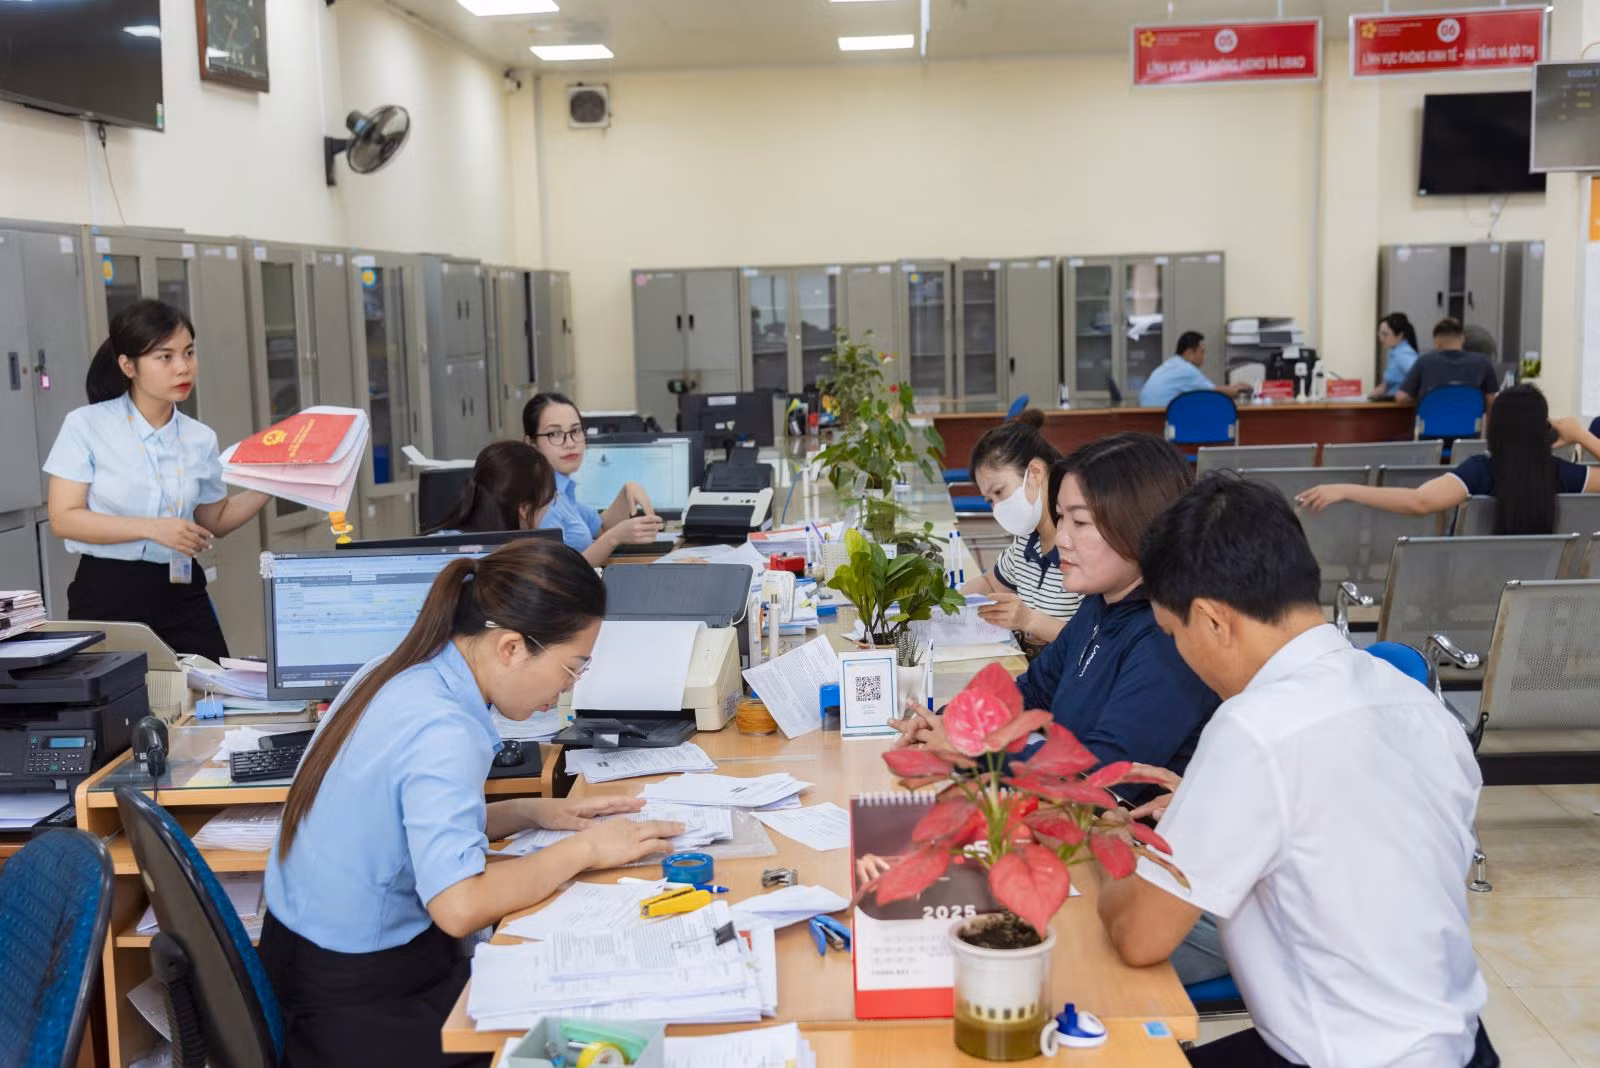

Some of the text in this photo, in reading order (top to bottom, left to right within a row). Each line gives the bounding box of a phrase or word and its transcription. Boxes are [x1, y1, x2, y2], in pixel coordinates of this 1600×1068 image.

[1440, 24, 1456, 36] 06
[1218, 35, 1233, 47] 05
[1427, 49, 1447, 63] KINH
[922, 903, 977, 920] 2025
